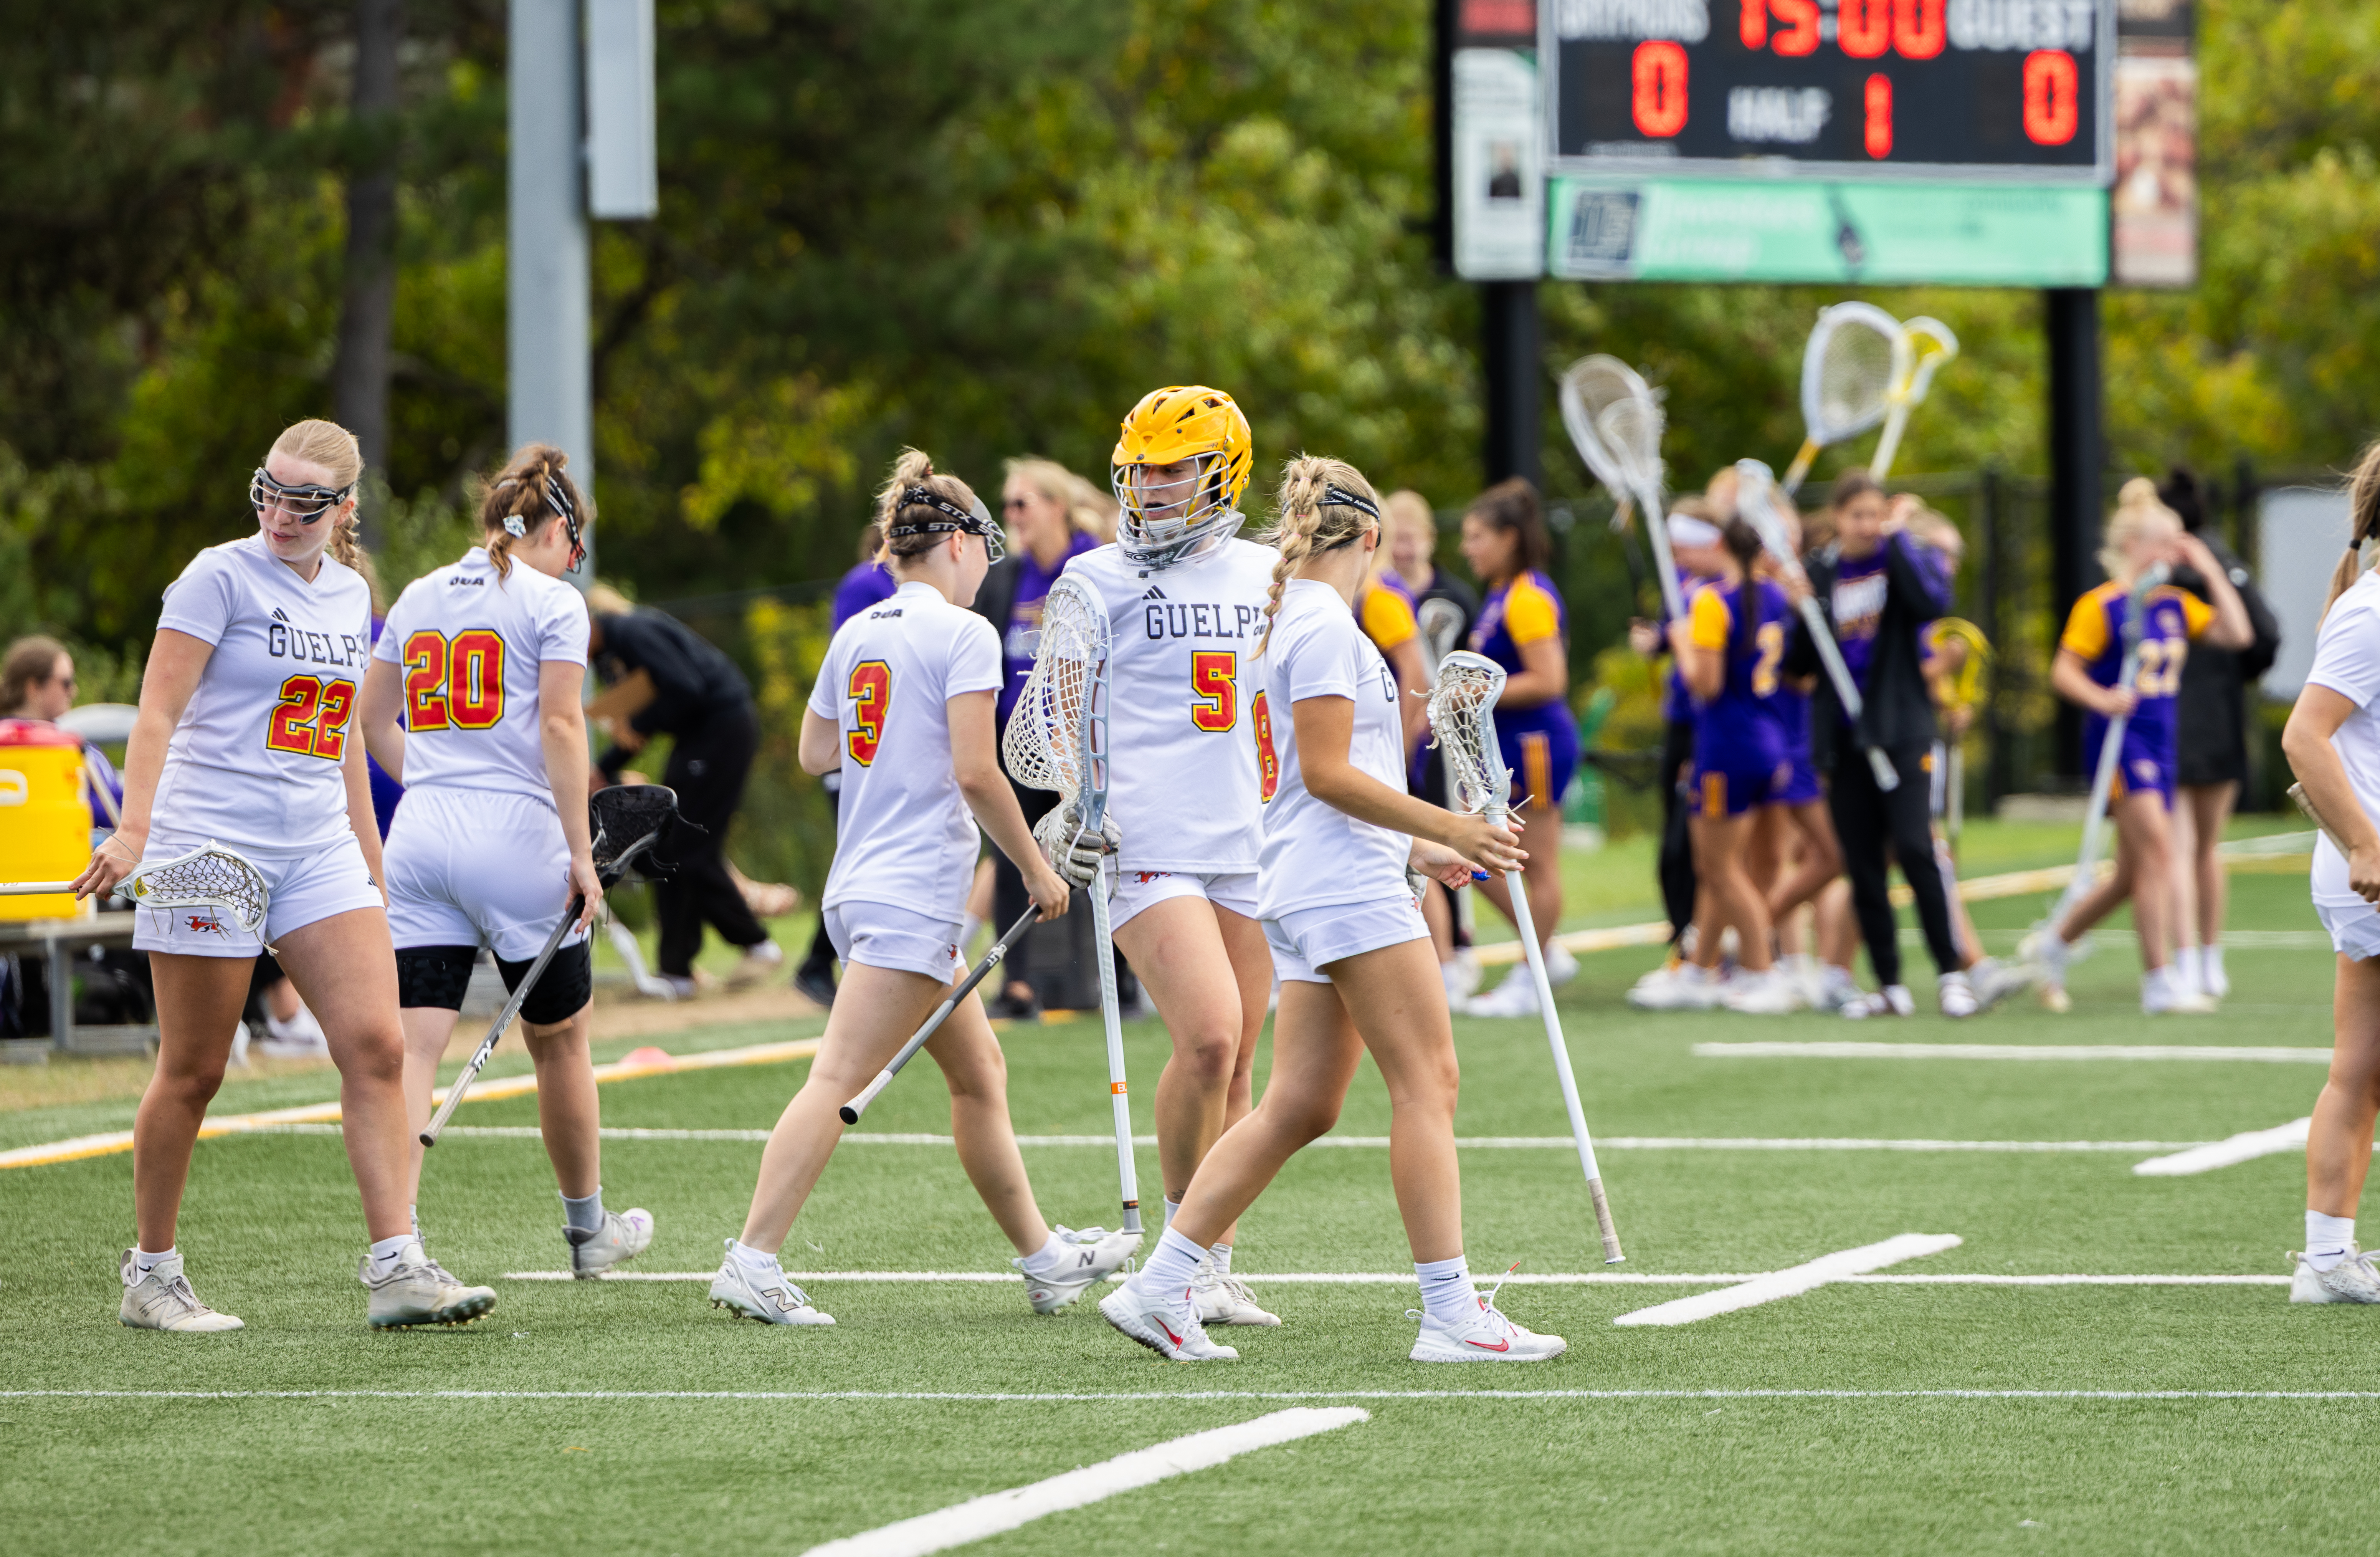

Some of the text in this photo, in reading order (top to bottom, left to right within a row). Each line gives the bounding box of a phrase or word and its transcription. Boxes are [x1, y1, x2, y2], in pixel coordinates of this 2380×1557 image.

[1632, 40, 1688, 137] 0
[1727, 85, 1832, 143] HALF
[2023, 49, 2078, 145] 0
[891, 524, 918, 537] STX
[928, 522, 962, 531] STX
[937, 501, 972, 524] STX
[1253, 624, 1267, 637] OU
[266, 673, 356, 762] 22
[403, 628, 505, 733] 20
[848, 659, 892, 768] 3
[1191, 650, 1236, 733] 5
